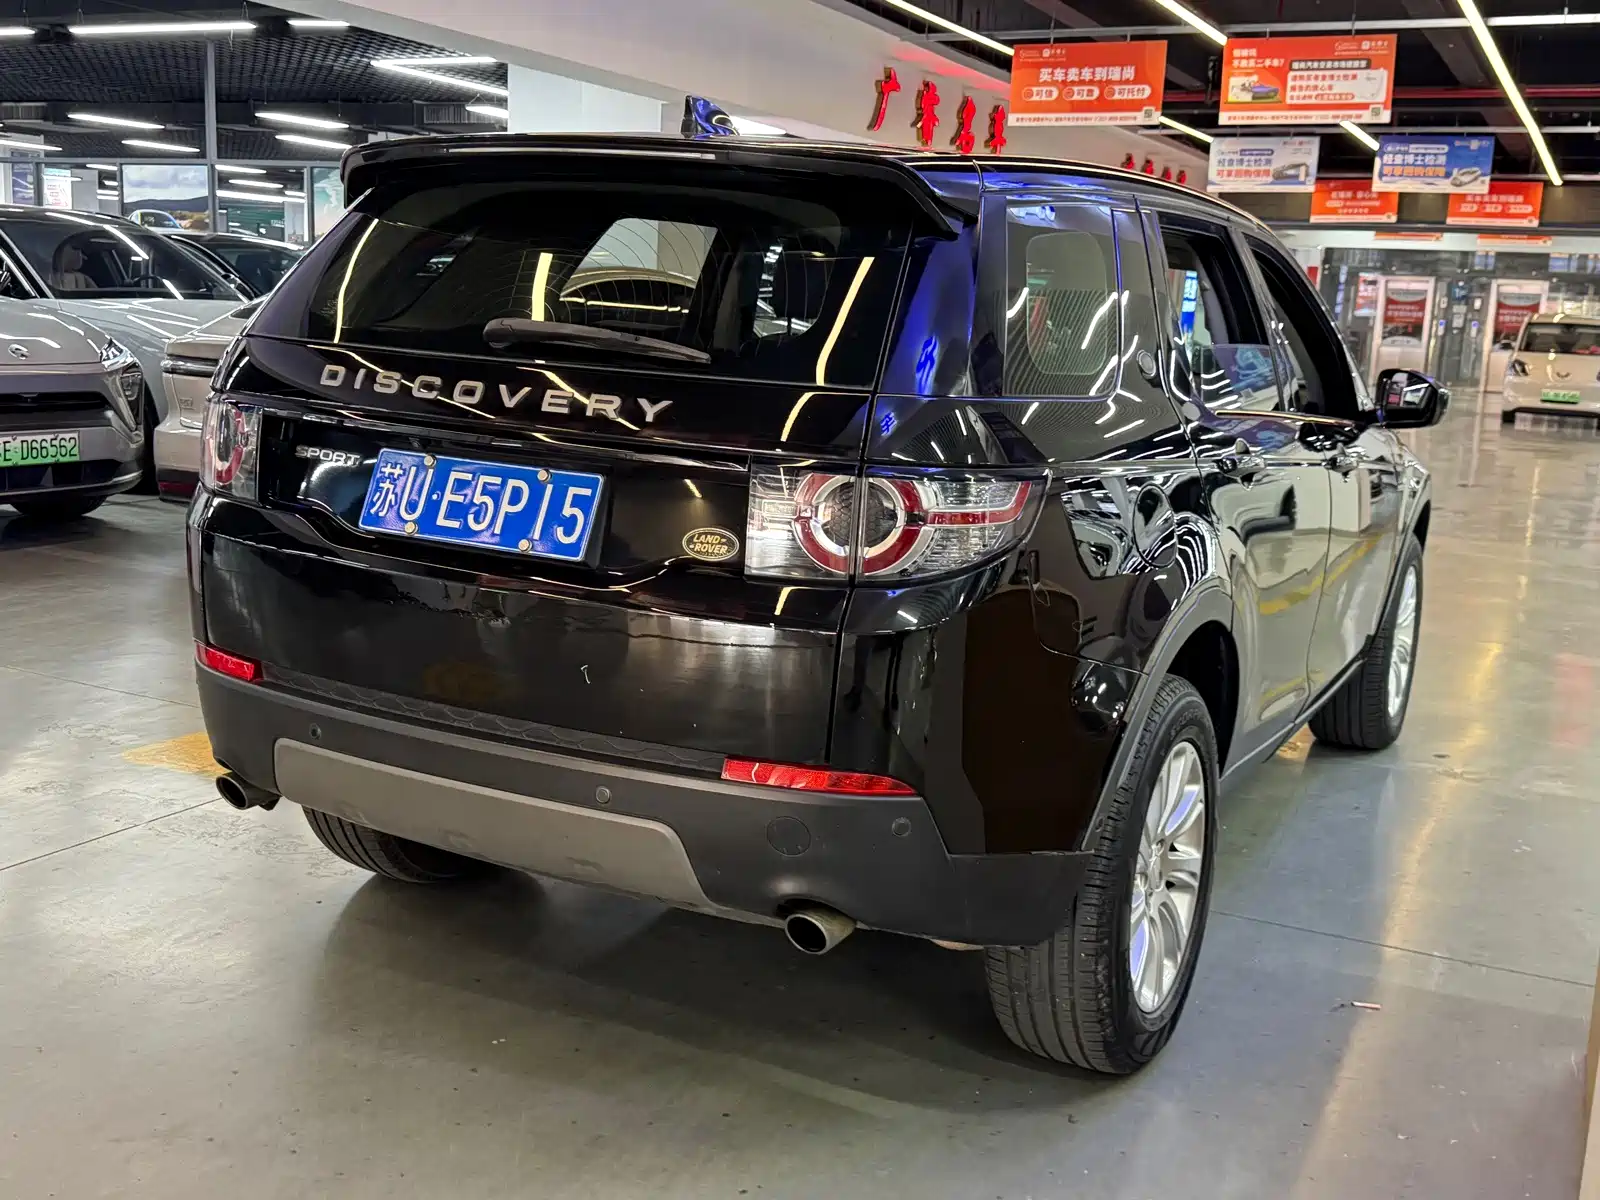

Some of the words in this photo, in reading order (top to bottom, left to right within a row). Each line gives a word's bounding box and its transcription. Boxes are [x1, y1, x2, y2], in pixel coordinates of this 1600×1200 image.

[1039, 65, 1136, 82] 买车卖车到瑞尚
[1035, 88, 1053, 100] 可信
[1117, 87, 1147, 98] 可托付
[320, 364, 673, 423] DISCOVERY
[0, 436, 77, 462] ED66562
[295, 444, 361, 466] SPORT
[693, 534, 720, 544] LAND
[694, 543, 728, 554] ROVER
